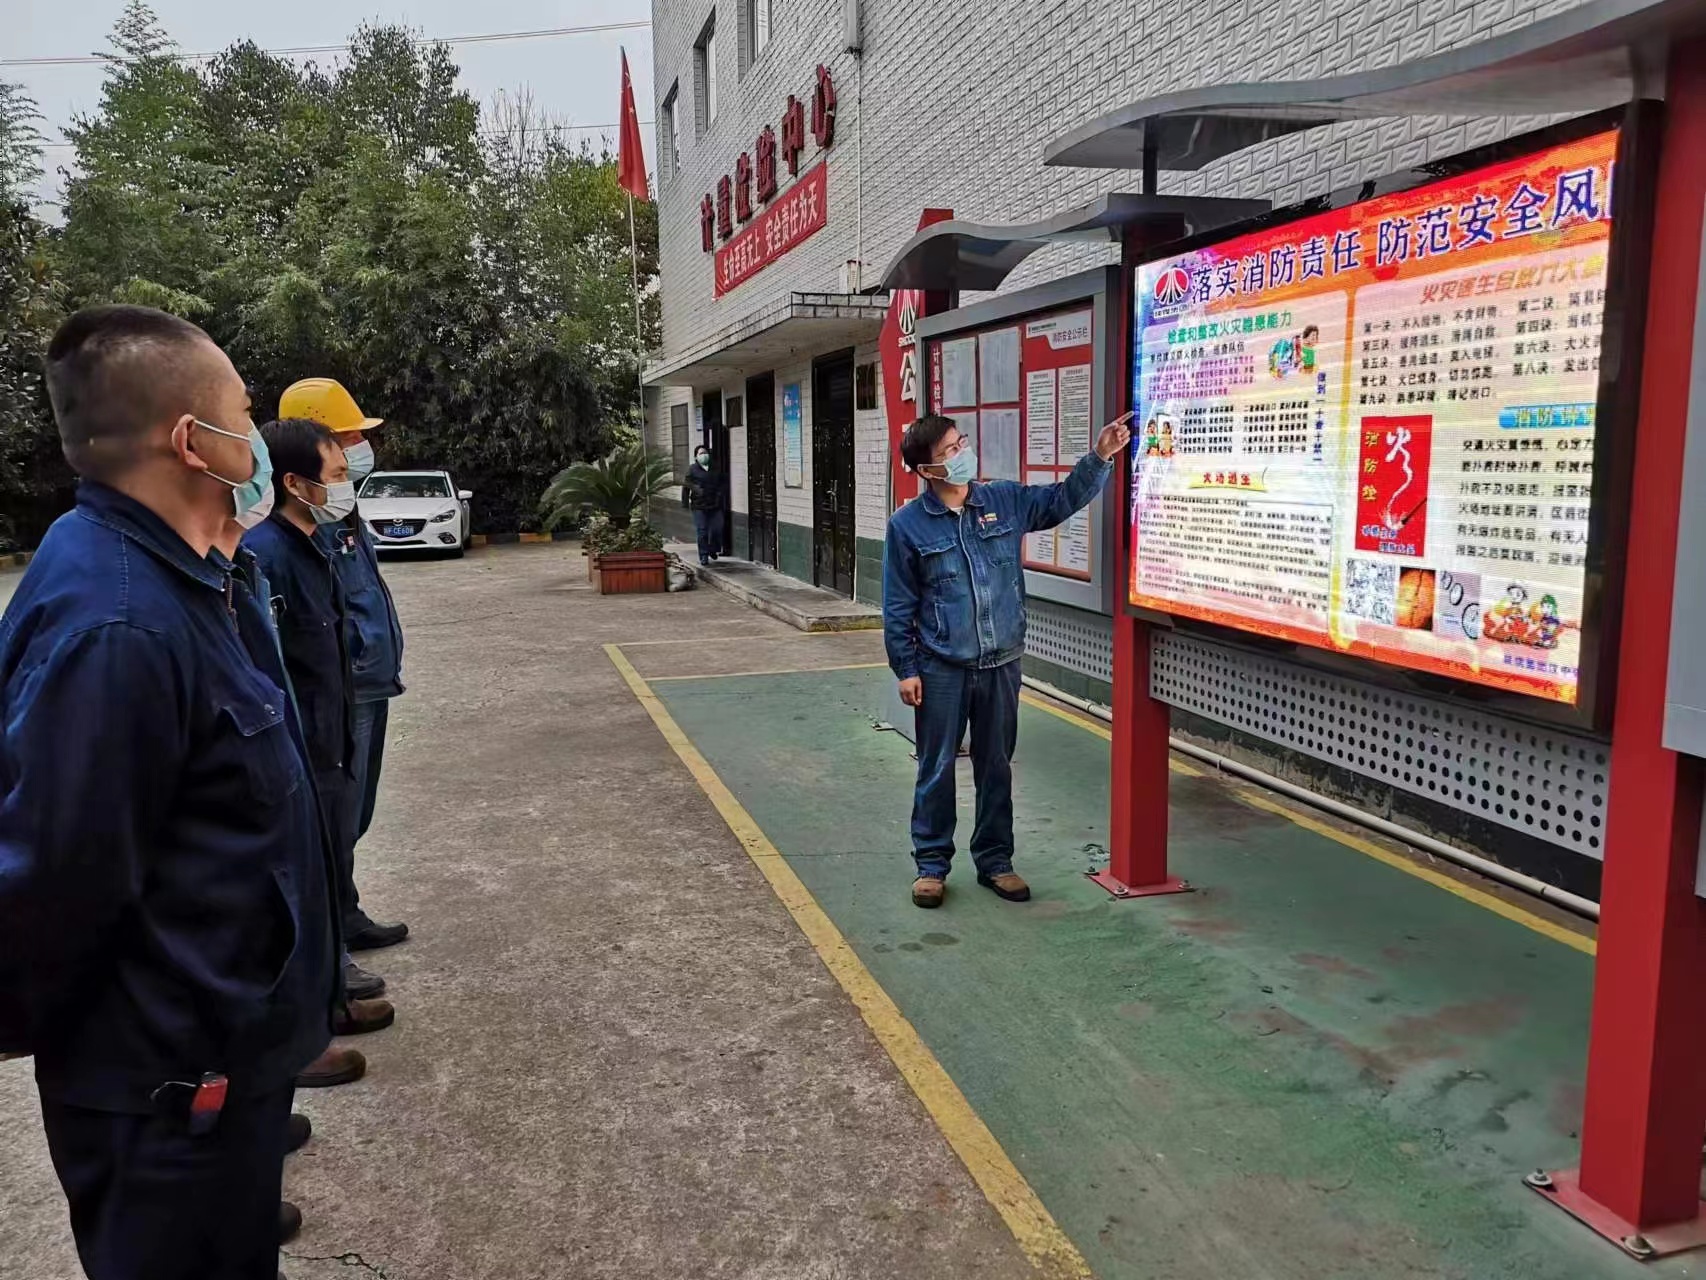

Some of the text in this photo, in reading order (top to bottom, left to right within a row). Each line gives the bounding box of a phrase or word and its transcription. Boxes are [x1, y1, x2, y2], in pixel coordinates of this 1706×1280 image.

[765, 182, 817, 255] 安全责任为天
[1191, 158, 1616, 303] 落实消防责任 防范安全风
[1167, 308, 1292, 346] 检查和整改火灾隐患能力
